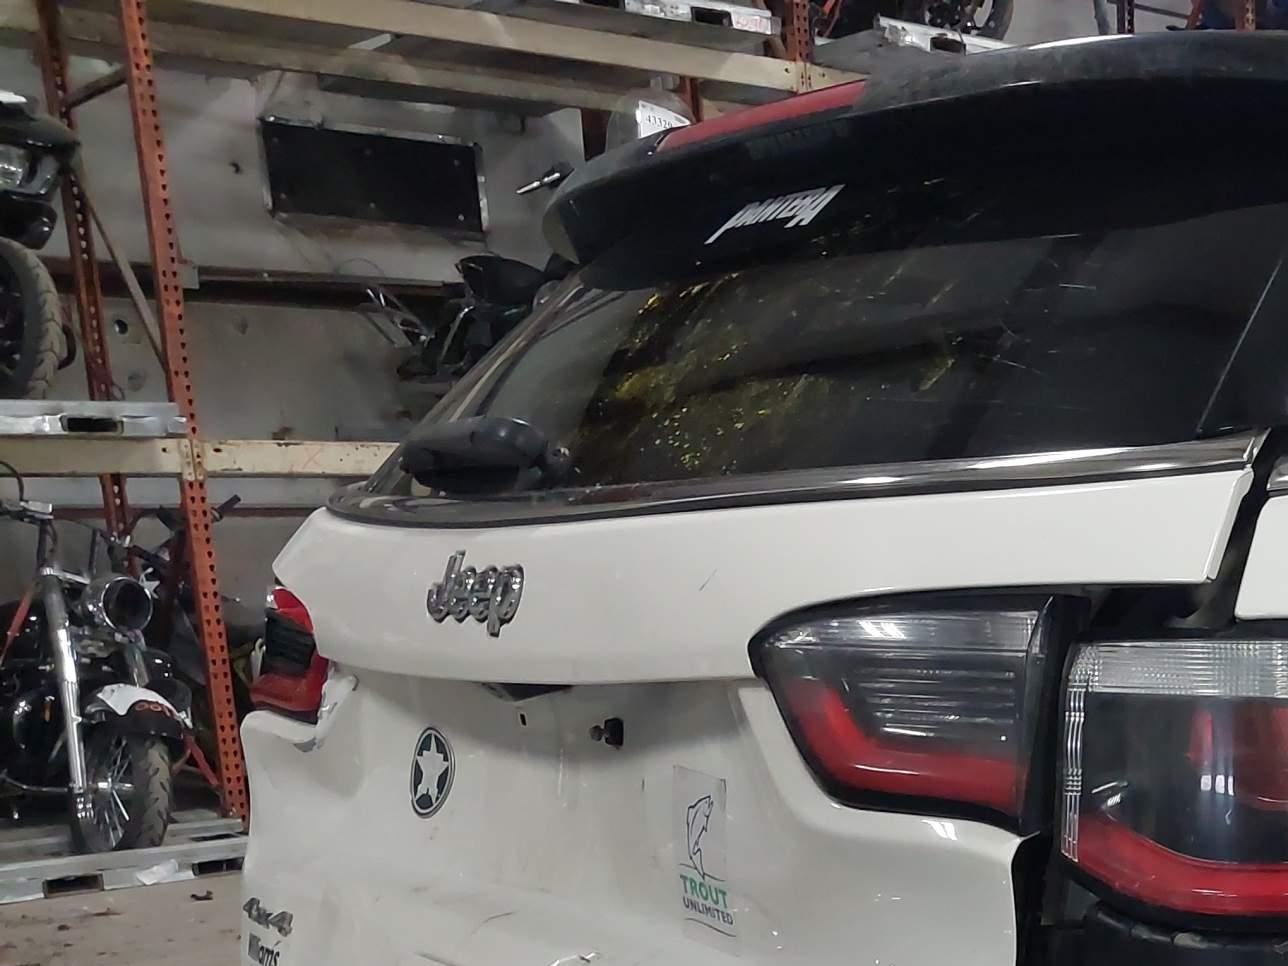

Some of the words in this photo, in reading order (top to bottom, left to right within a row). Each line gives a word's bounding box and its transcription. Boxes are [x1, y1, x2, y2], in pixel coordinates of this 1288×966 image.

[427, 549, 525, 638] Jeep
[679, 874, 728, 909] TROUT
[682, 897, 734, 925] UNLIMITED
